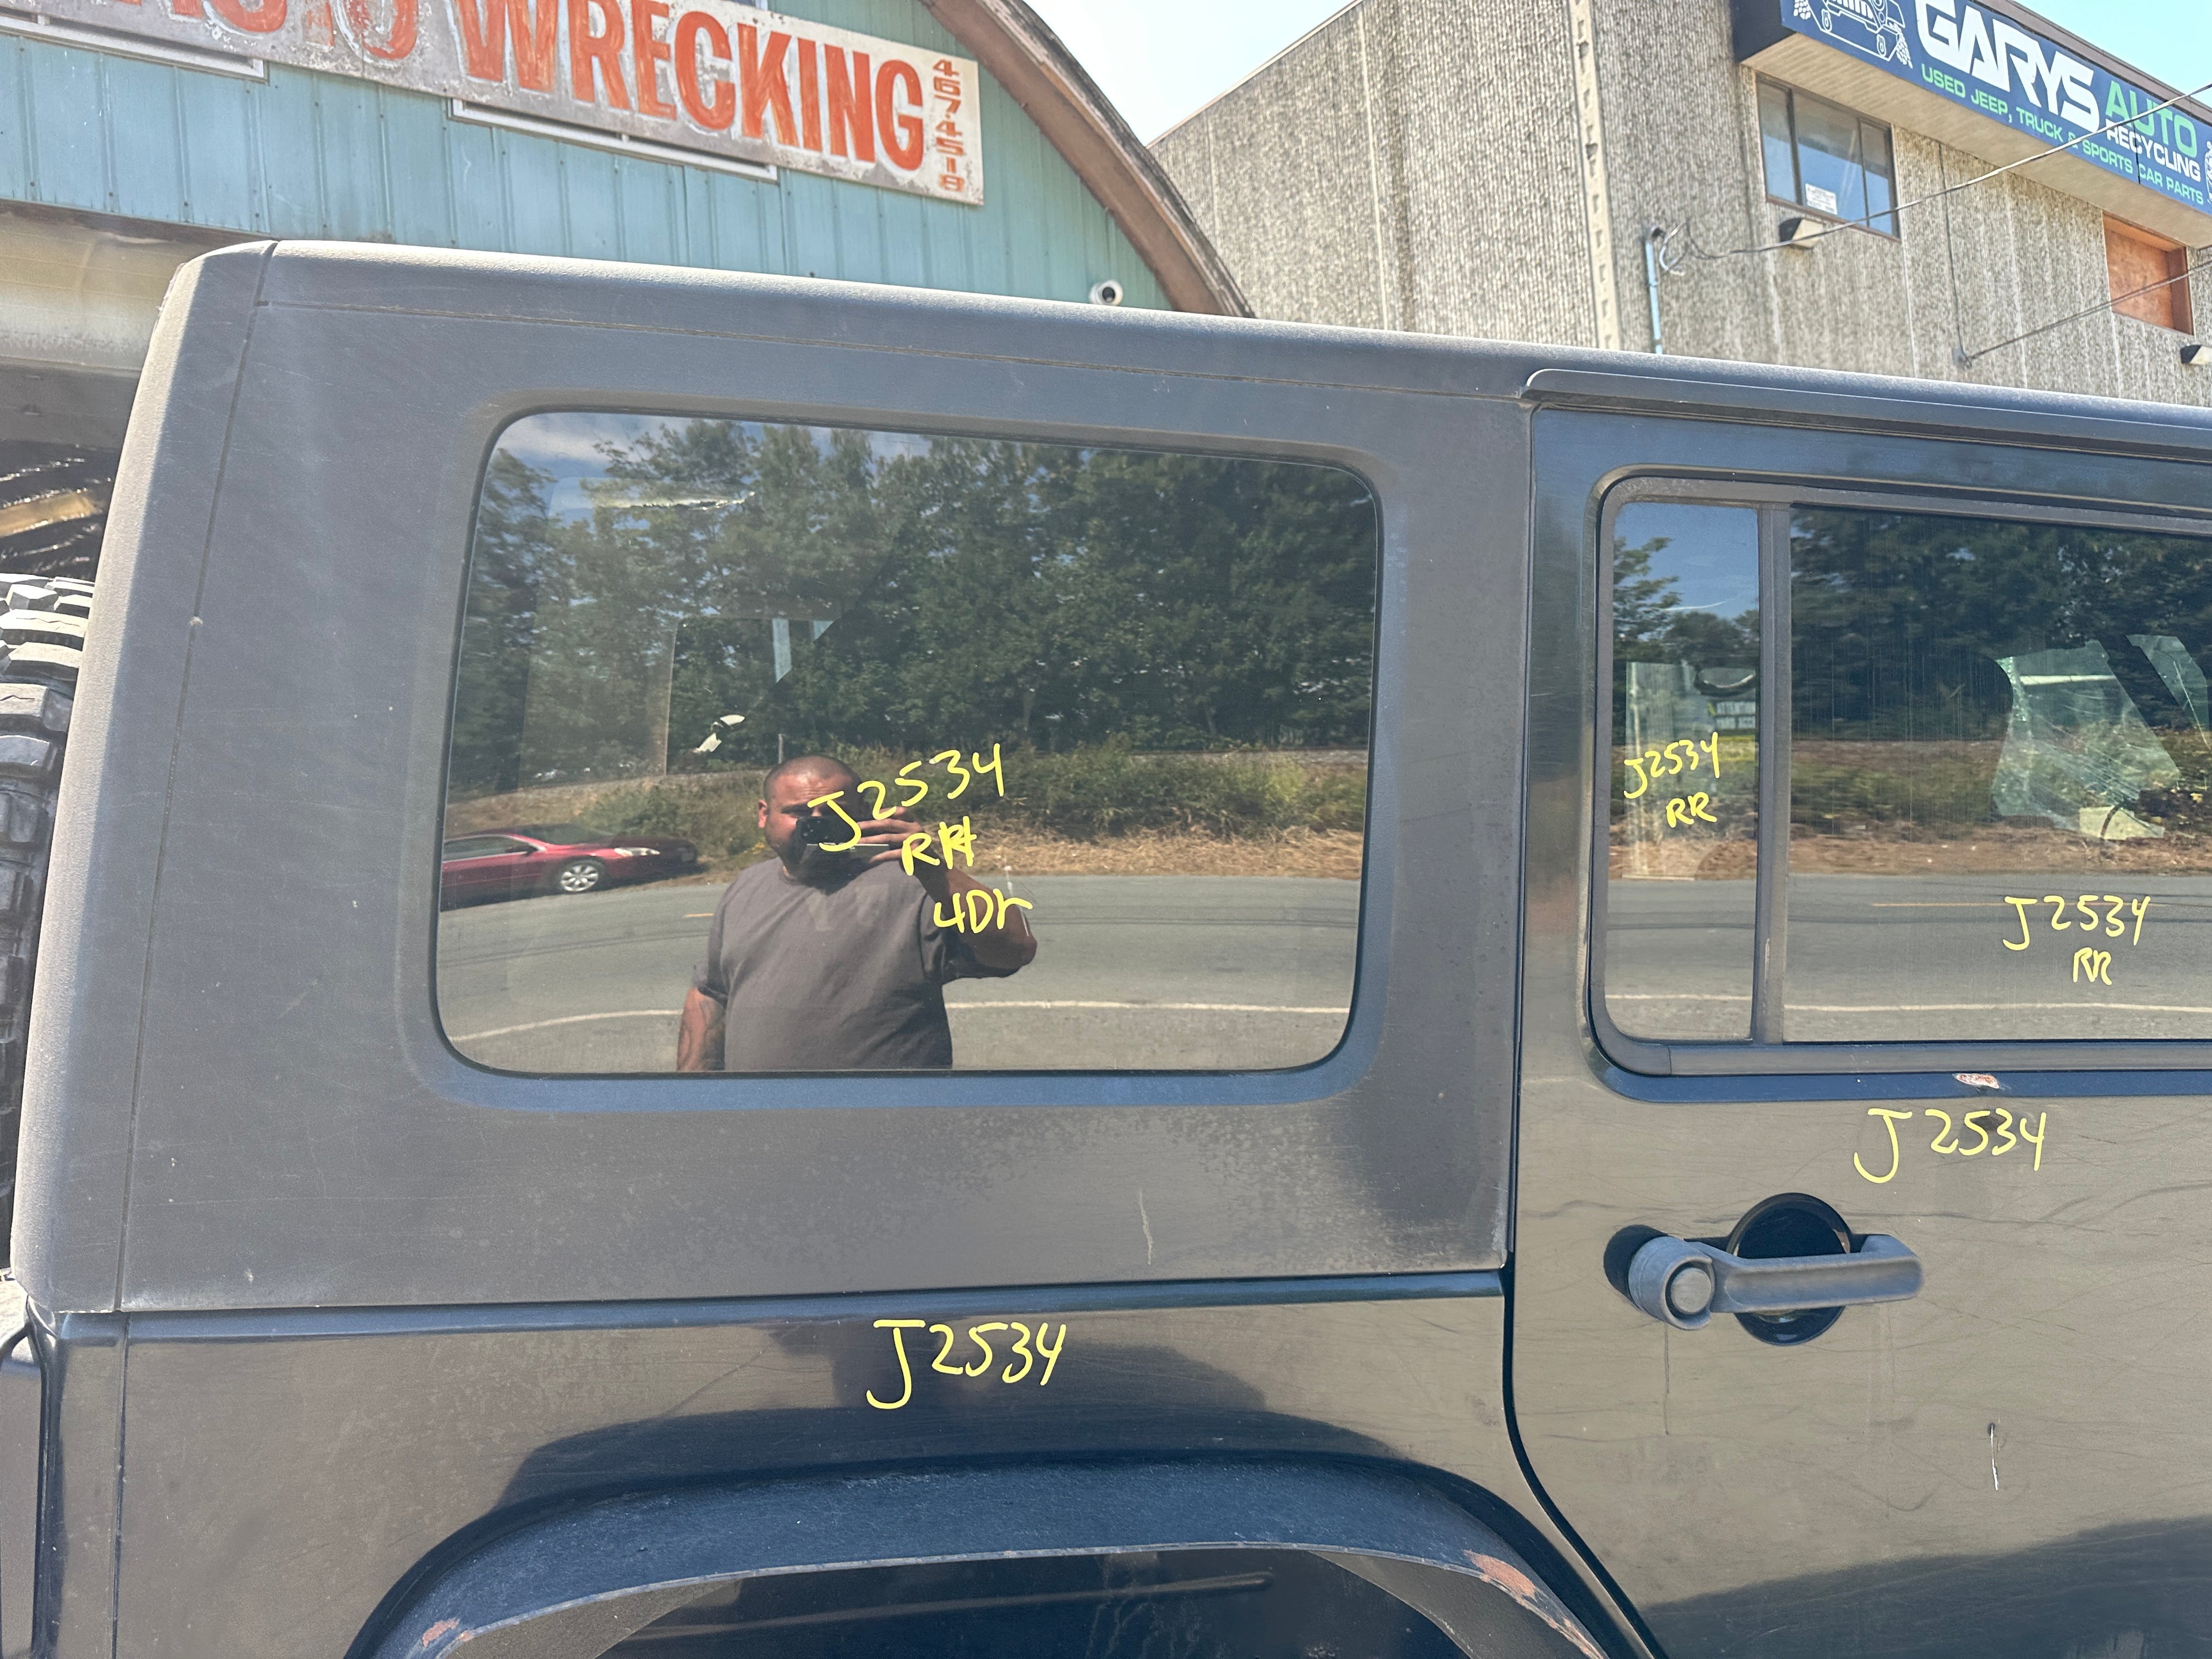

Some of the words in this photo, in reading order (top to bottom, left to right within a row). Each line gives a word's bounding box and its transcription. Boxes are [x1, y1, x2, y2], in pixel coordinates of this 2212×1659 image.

[455, 0, 923, 171] WRECKING
[1914, 0, 2100, 134] GARYS
[1921, 63, 1965, 99] USED
[1970, 89, 2013, 123] JEEP,
[2016, 107, 2063, 143] TRUCK
[2068, 132, 2078, 150] &
[2082, 139, 2134, 174] SPORTS
[2138, 163, 2163, 187] CAR
[2166, 176, 2204, 205] PARTS
[2105, 80, 2198, 158] AUTO
[2105, 118, 2201, 182] RECYCLING
[807, 743, 1004, 851] J2534
[1623, 732, 1719, 799] J2534
[1666, 791, 1717, 828] RR
[2002, 895, 2151, 950] J2534
[1854, 1108, 2047, 1184] J2534
[866, 1319, 1067, 1410] J2534
